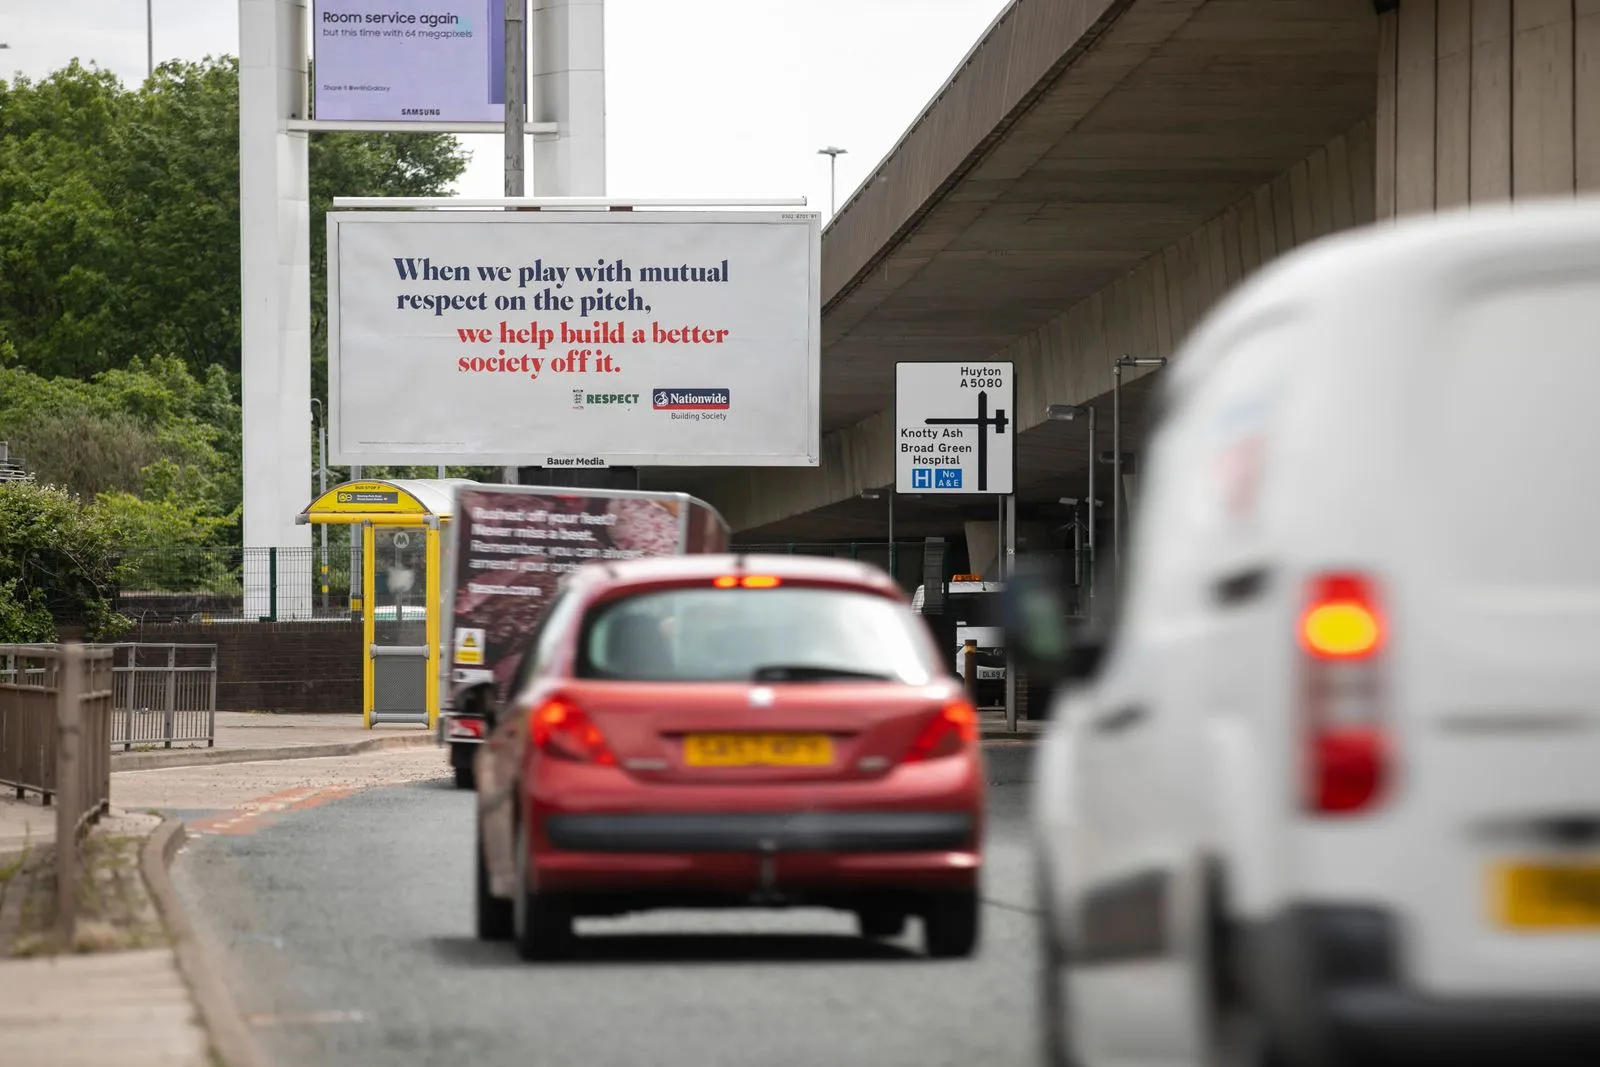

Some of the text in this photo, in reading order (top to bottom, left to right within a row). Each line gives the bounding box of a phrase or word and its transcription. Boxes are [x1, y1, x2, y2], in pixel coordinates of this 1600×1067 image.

[323, 11, 459, 27] Room service again
[323, 29, 472, 40] but this time with 64 megapixels
[401, 108, 441, 116] SAMSUNG
[393, 257, 728, 289] When we play with mutual
[397, 287, 652, 317] respect on the pitch,
[457, 321, 729, 350] we help build a better
[458, 349, 621, 379] society off it.
[960, 366, 1001, 377] Huyton
[586, 394, 639, 404] RESPECT
[670, 393, 727, 404] Nationwide
[671, 413, 727, 421] Building Society
[901, 428, 963, 439] Knotty Ash
[901, 443, 972, 452] Broad Green
[547, 457, 605, 465] Bauer Media
[913, 455, 960, 465] Hospital
[915, 470, 929, 487] H
[942, 470, 955, 478] No
[548, 513, 578, 525] your
[471, 523, 512, 537] Never
[548, 546, 575, 558] you
[575, 547, 600, 557] can
[519, 562, 548, 573] your
